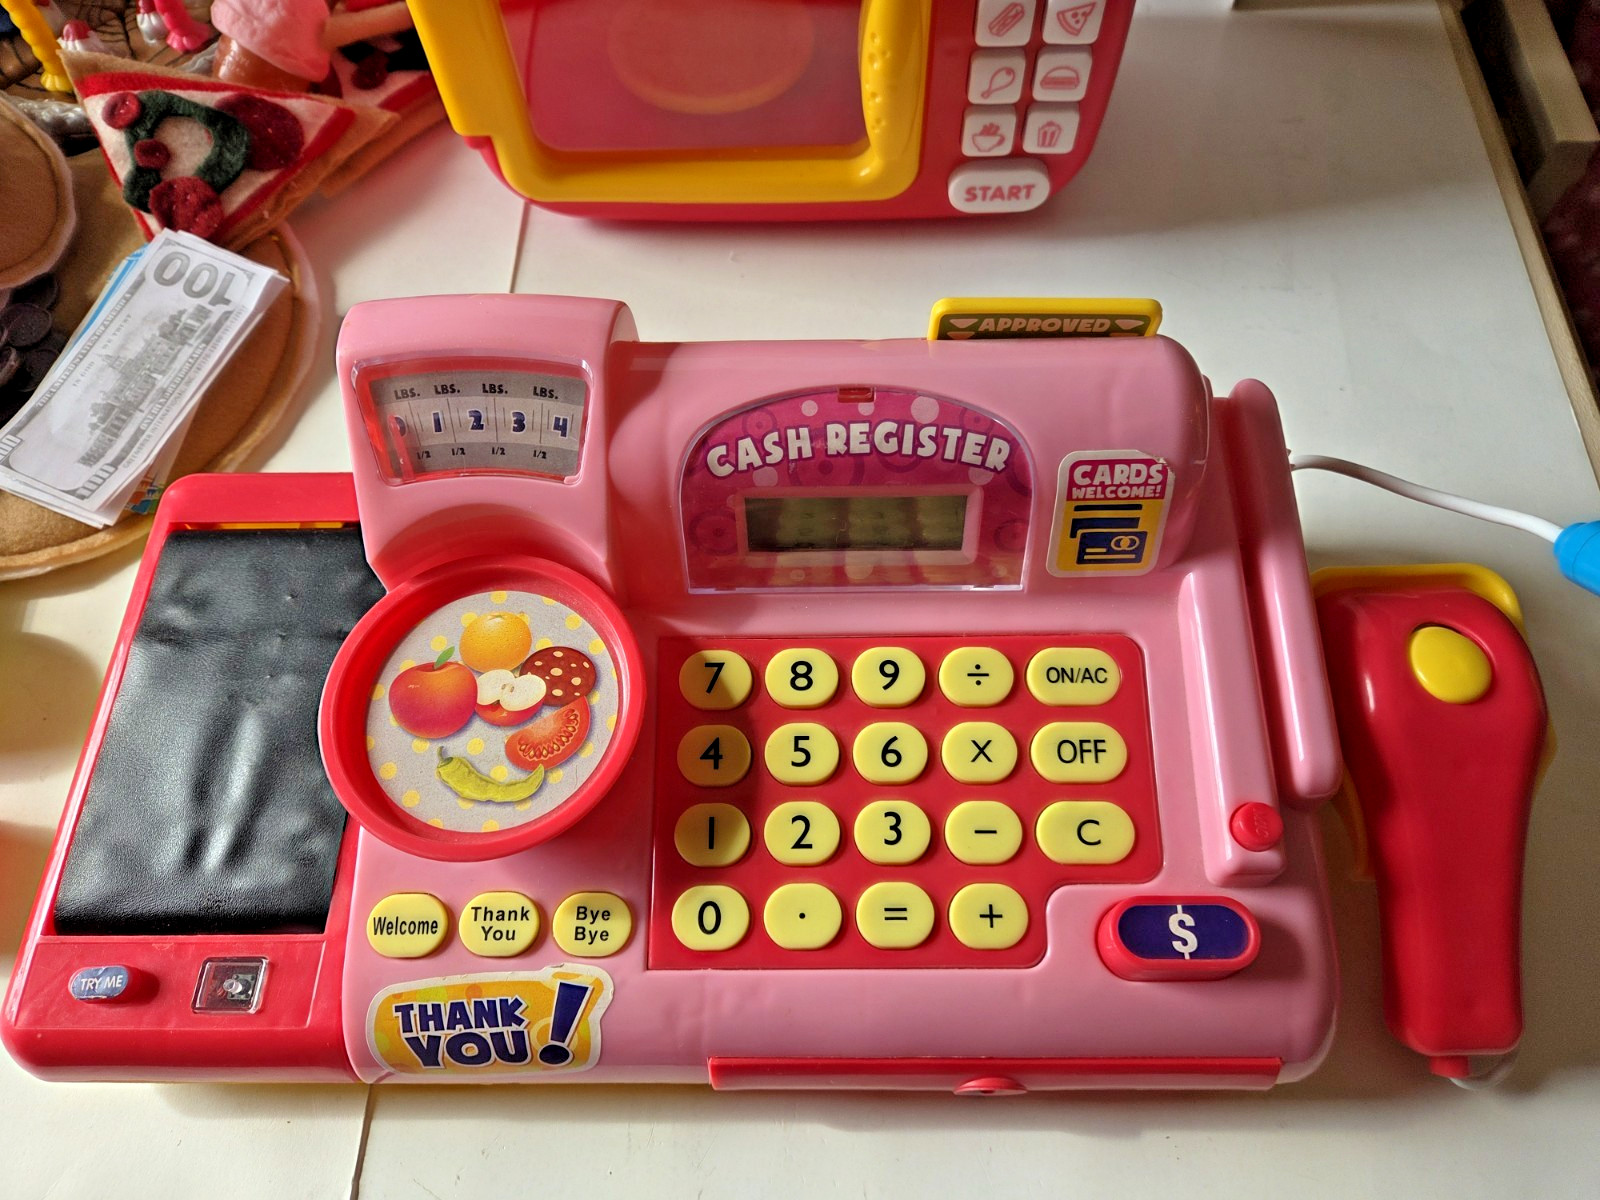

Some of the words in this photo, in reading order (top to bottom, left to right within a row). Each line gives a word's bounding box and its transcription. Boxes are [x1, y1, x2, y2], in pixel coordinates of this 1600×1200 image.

[964, 183, 1035, 202] START
[153, 250, 236, 306] 100
[978, 318, 1111, 332] APPROVED
[394, 387, 421, 400] LBS.
[433, 383, 461, 395] LBS.
[482, 383, 508, 395] LBS.
[533, 386, 559, 400] LBS.
[432, 412, 443, 433] 1
[468, 410, 484, 431] 2
[512, 411, 526, 433] 3
[553, 416, 568, 438] 4
[705, 425, 813, 478] CASH
[824, 421, 1012, 473] REGISTER
[1073, 463, 1163, 486] CARDS
[1072, 485, 1162, 500] WELCOME!
[704, 662, 725, 694] 7
[790, 661, 813, 691] 8
[879, 660, 899, 690] 9
[1046, 666, 1108, 684] ON/AC
[699, 737, 723, 770] 4
[791, 736, 811, 767] 5
[881, 736, 902, 767] 6
[1057, 740, 1106, 763] OFF
[708, 816, 715, 849] 1
[791, 815, 812, 849] 2
[884, 812, 902, 846] 3
[1077, 820, 1101, 845] C
[373, 916, 438, 936] Welcome
[471, 906, 530, 922] Thank
[576, 906, 611, 924] Bye
[697, 901, 721, 935] 0
[481, 926, 516, 941] You
[574, 926, 609, 945] Bye
[80, 977, 102, 991] TRY
[104, 974, 123, 988] ME
[394, 996, 528, 1033] THANK
